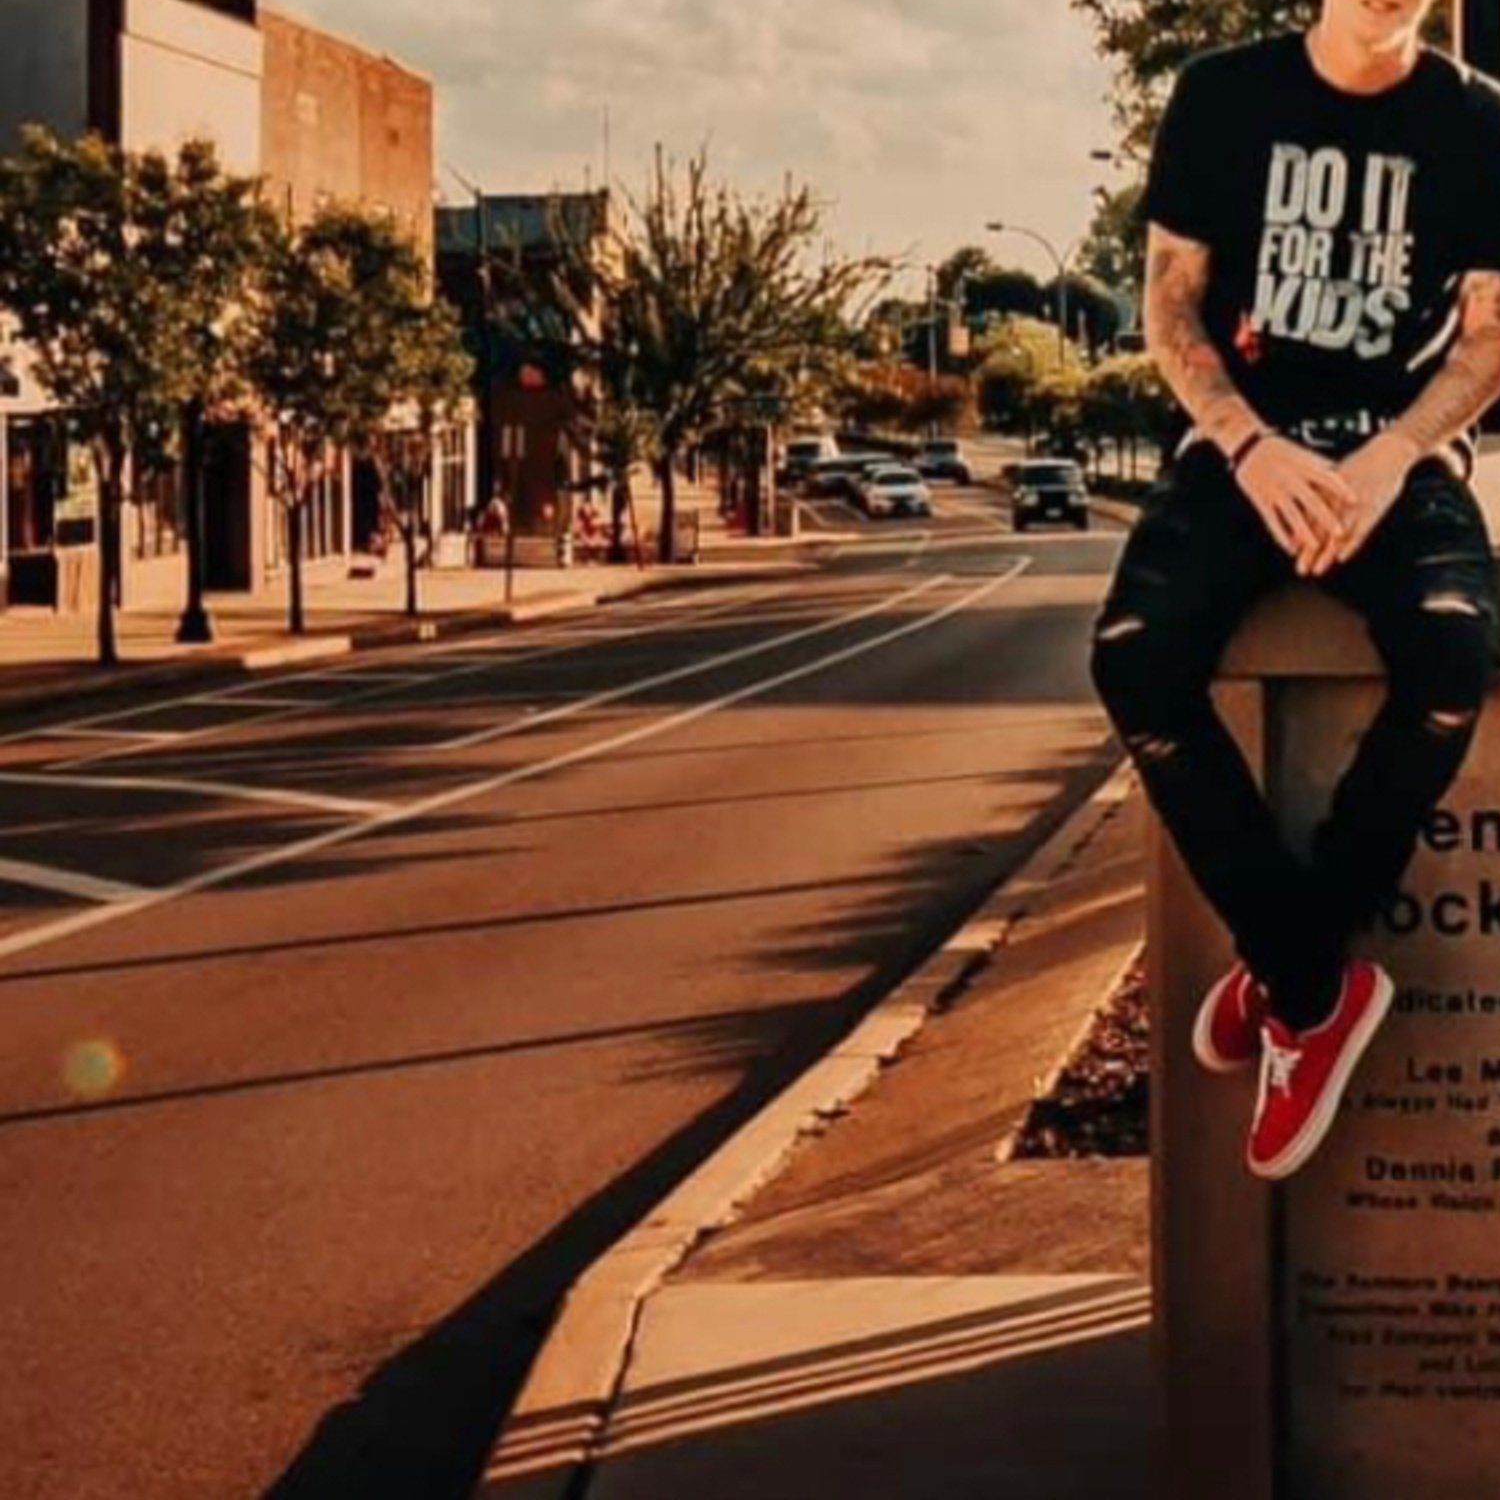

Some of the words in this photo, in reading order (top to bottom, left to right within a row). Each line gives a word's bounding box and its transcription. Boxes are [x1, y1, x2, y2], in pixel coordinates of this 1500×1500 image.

[1264, 143, 1348, 229] DO
[1361, 152, 1416, 233] IT
[1258, 226, 1332, 276] FOR
[1347, 231, 1414, 288] THE
[1250, 272, 1411, 359] KIDS
[1407, 1060, 1462, 1084] Lee
